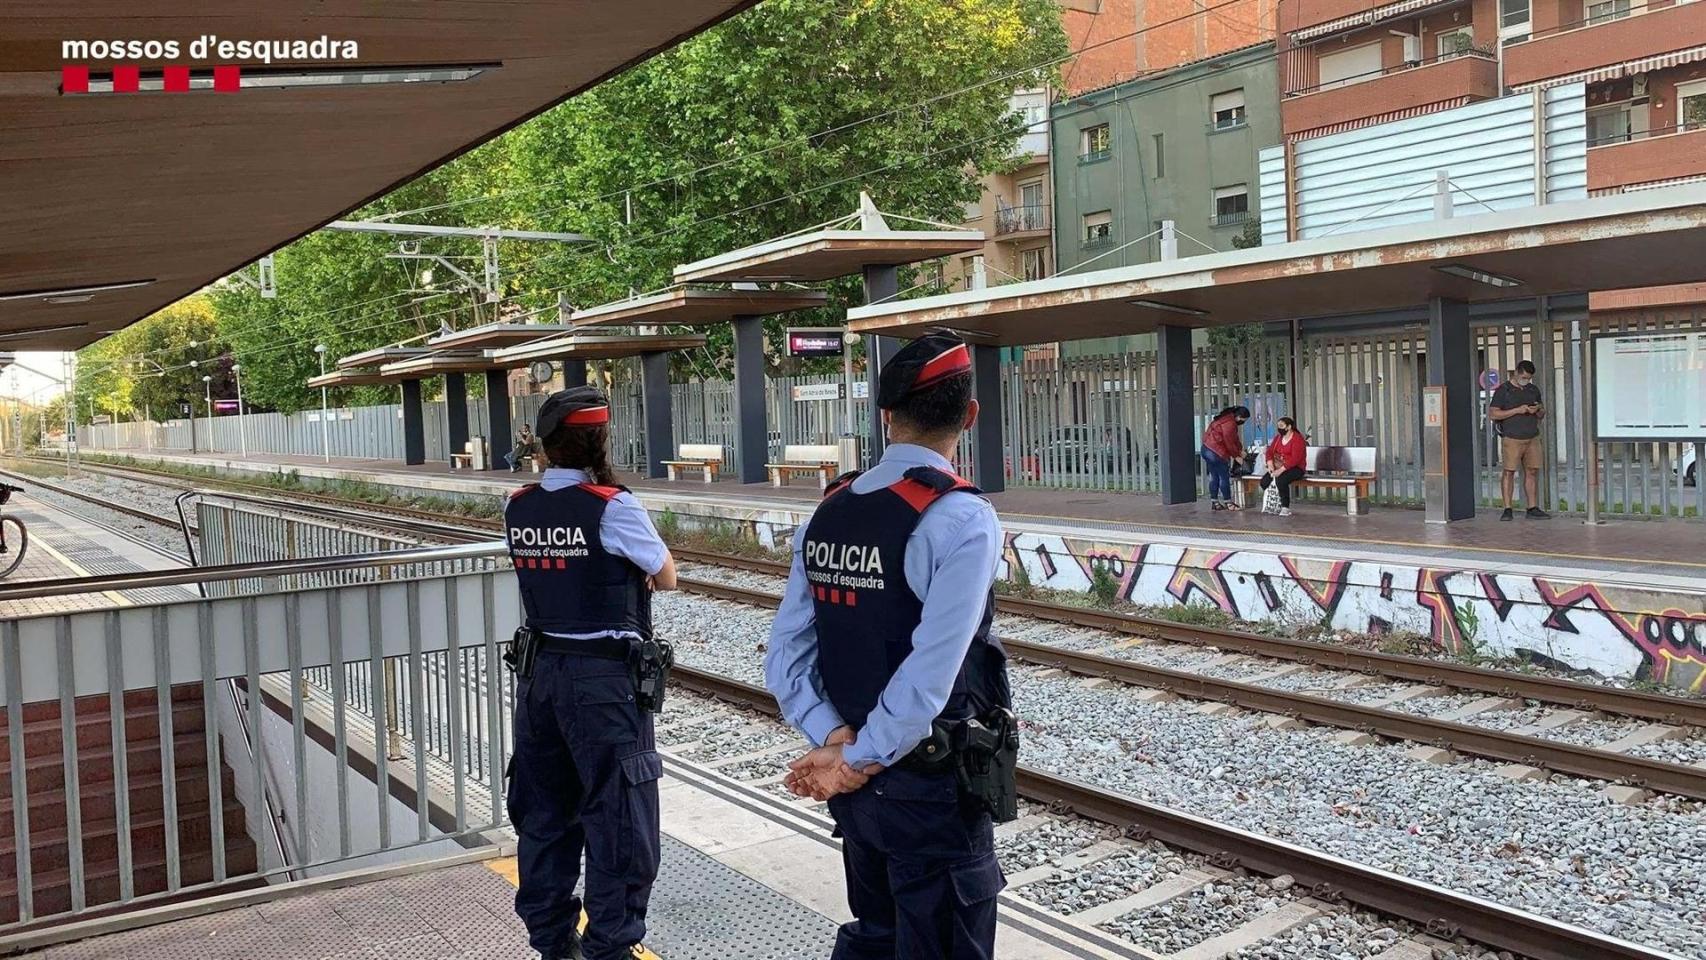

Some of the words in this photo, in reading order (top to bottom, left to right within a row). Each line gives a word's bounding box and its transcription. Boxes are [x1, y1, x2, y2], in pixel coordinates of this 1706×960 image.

[510, 527, 587, 546] POLICIA
[513, 548, 542, 557] mossos
[543, 547, 589, 558] d'esquadra
[806, 540, 883, 574] POLICIA
[832, 572, 885, 590] d'esquadra
